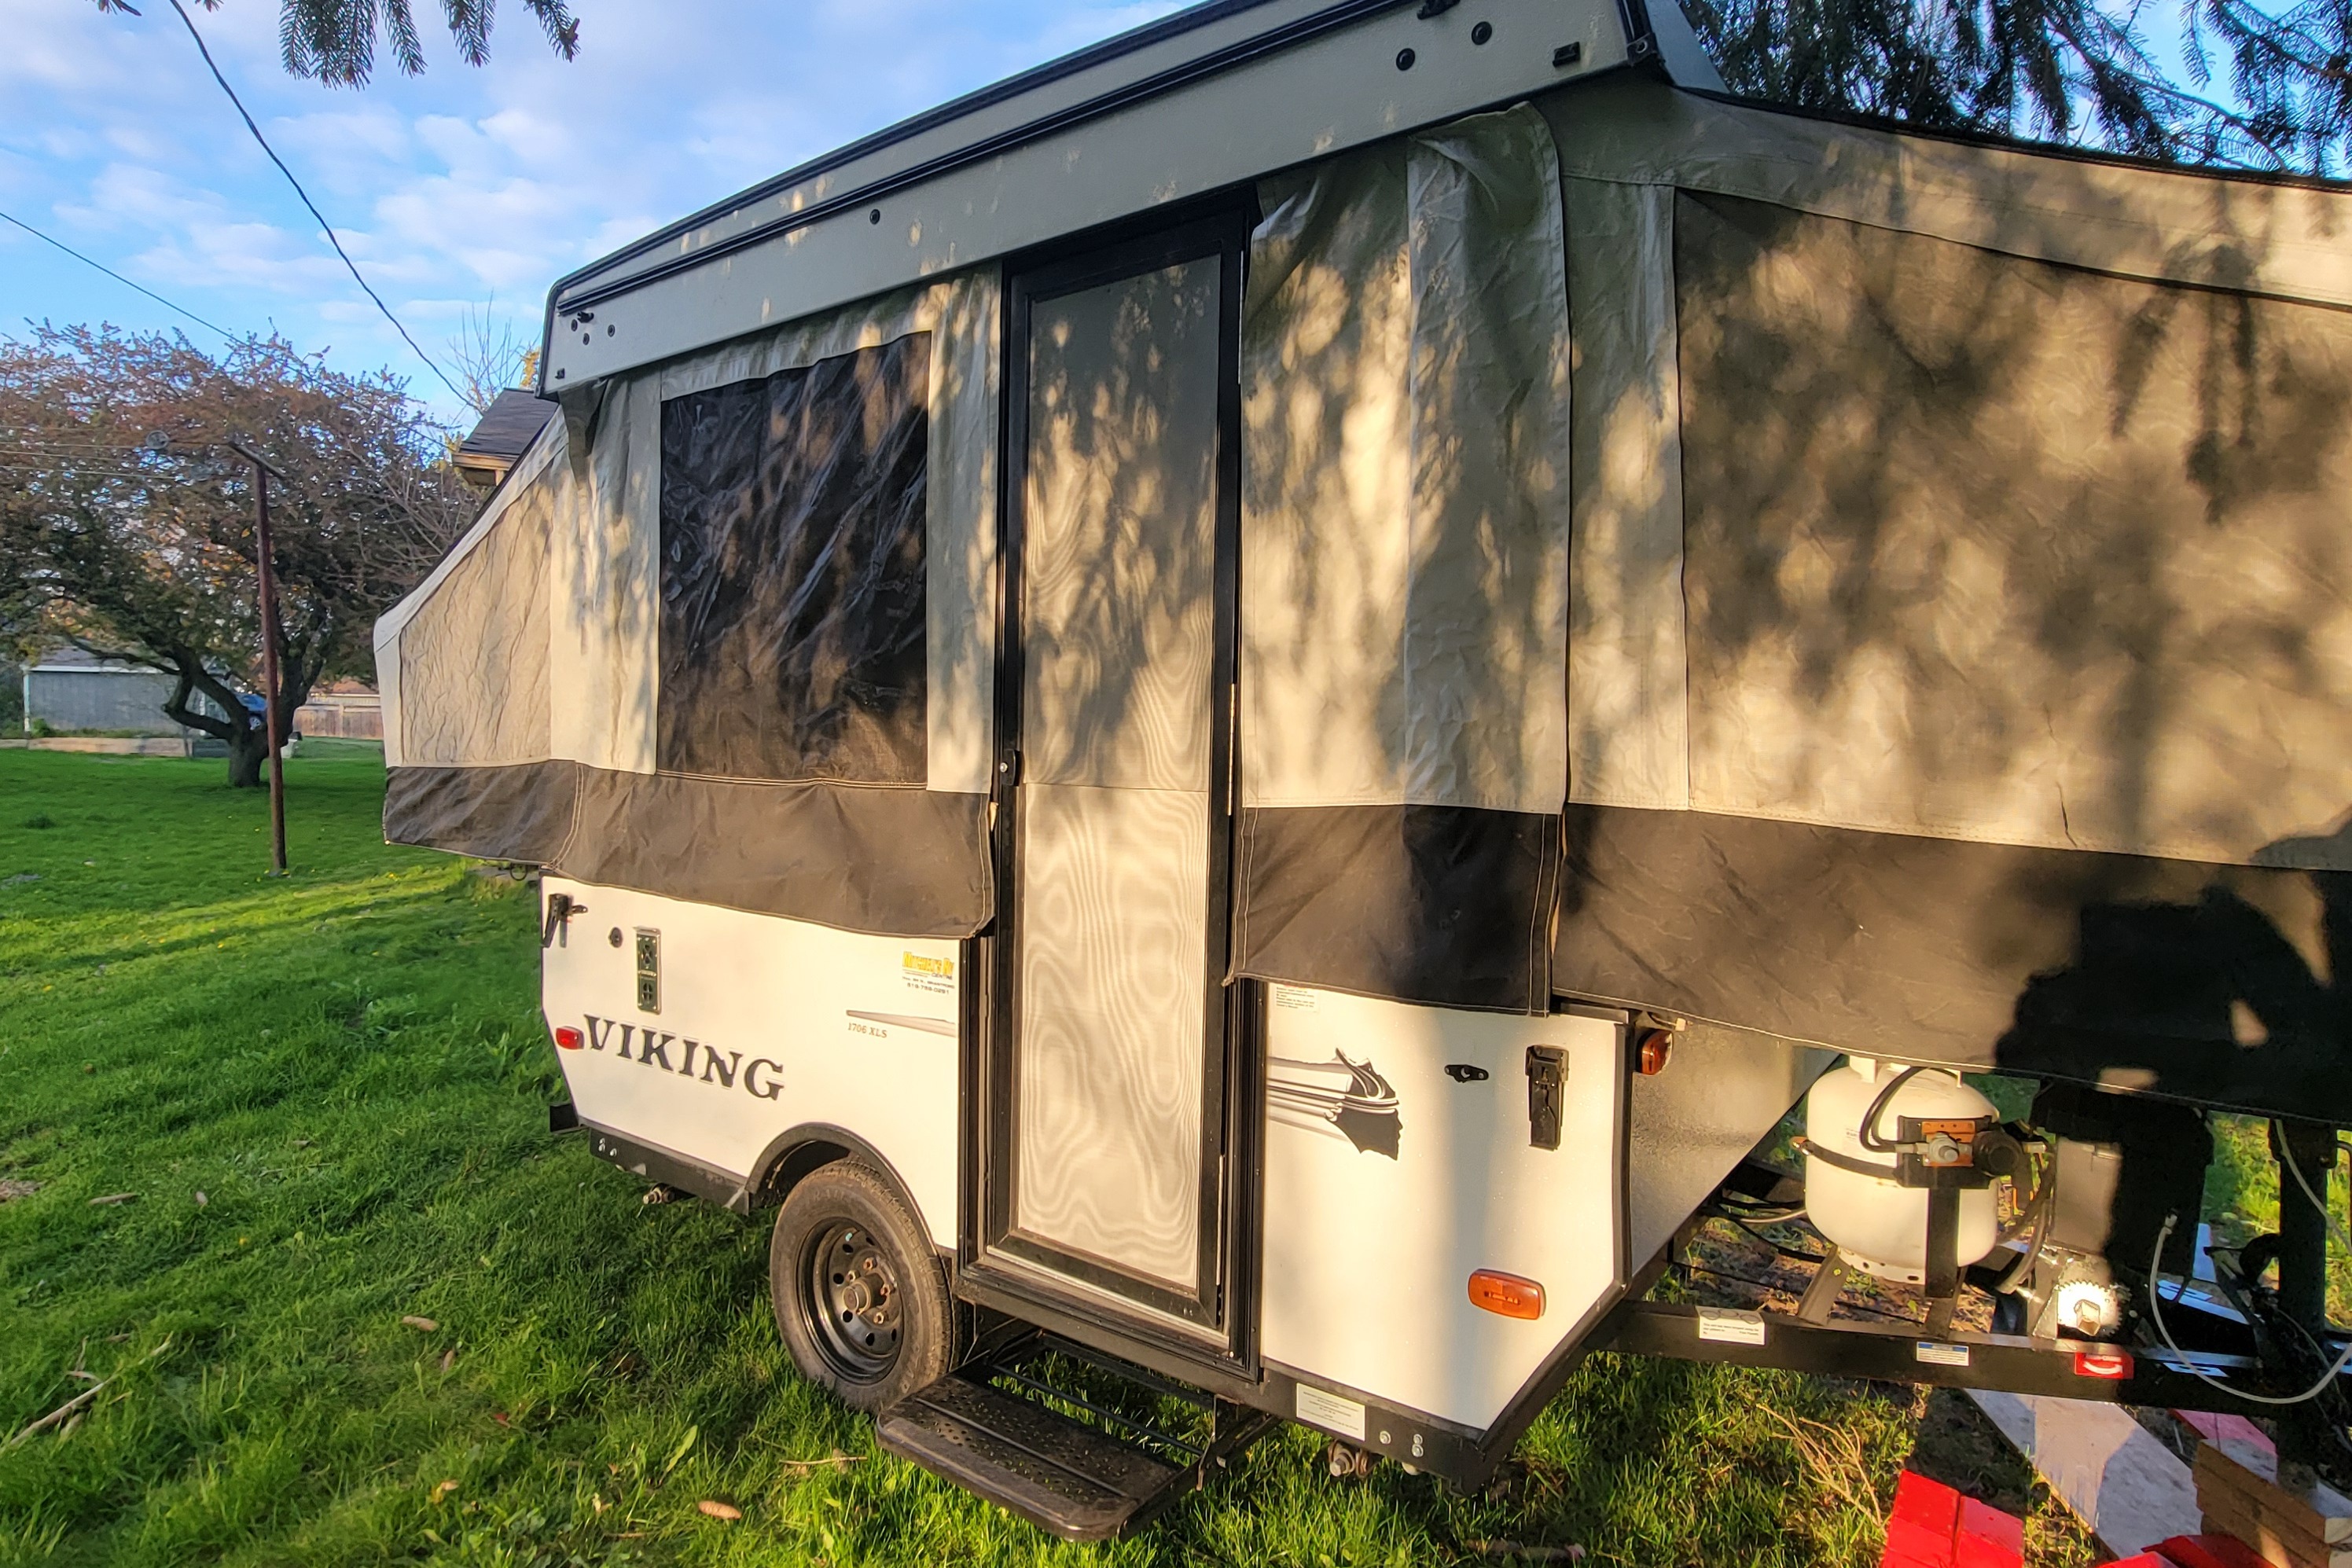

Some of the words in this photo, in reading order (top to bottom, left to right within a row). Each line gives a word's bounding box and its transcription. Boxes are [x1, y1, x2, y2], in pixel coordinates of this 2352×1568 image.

[848, 1022, 867, 1034] 1706
[869, 1026, 888, 1038] XLS
[584, 1014, 785, 1100] VIKING
